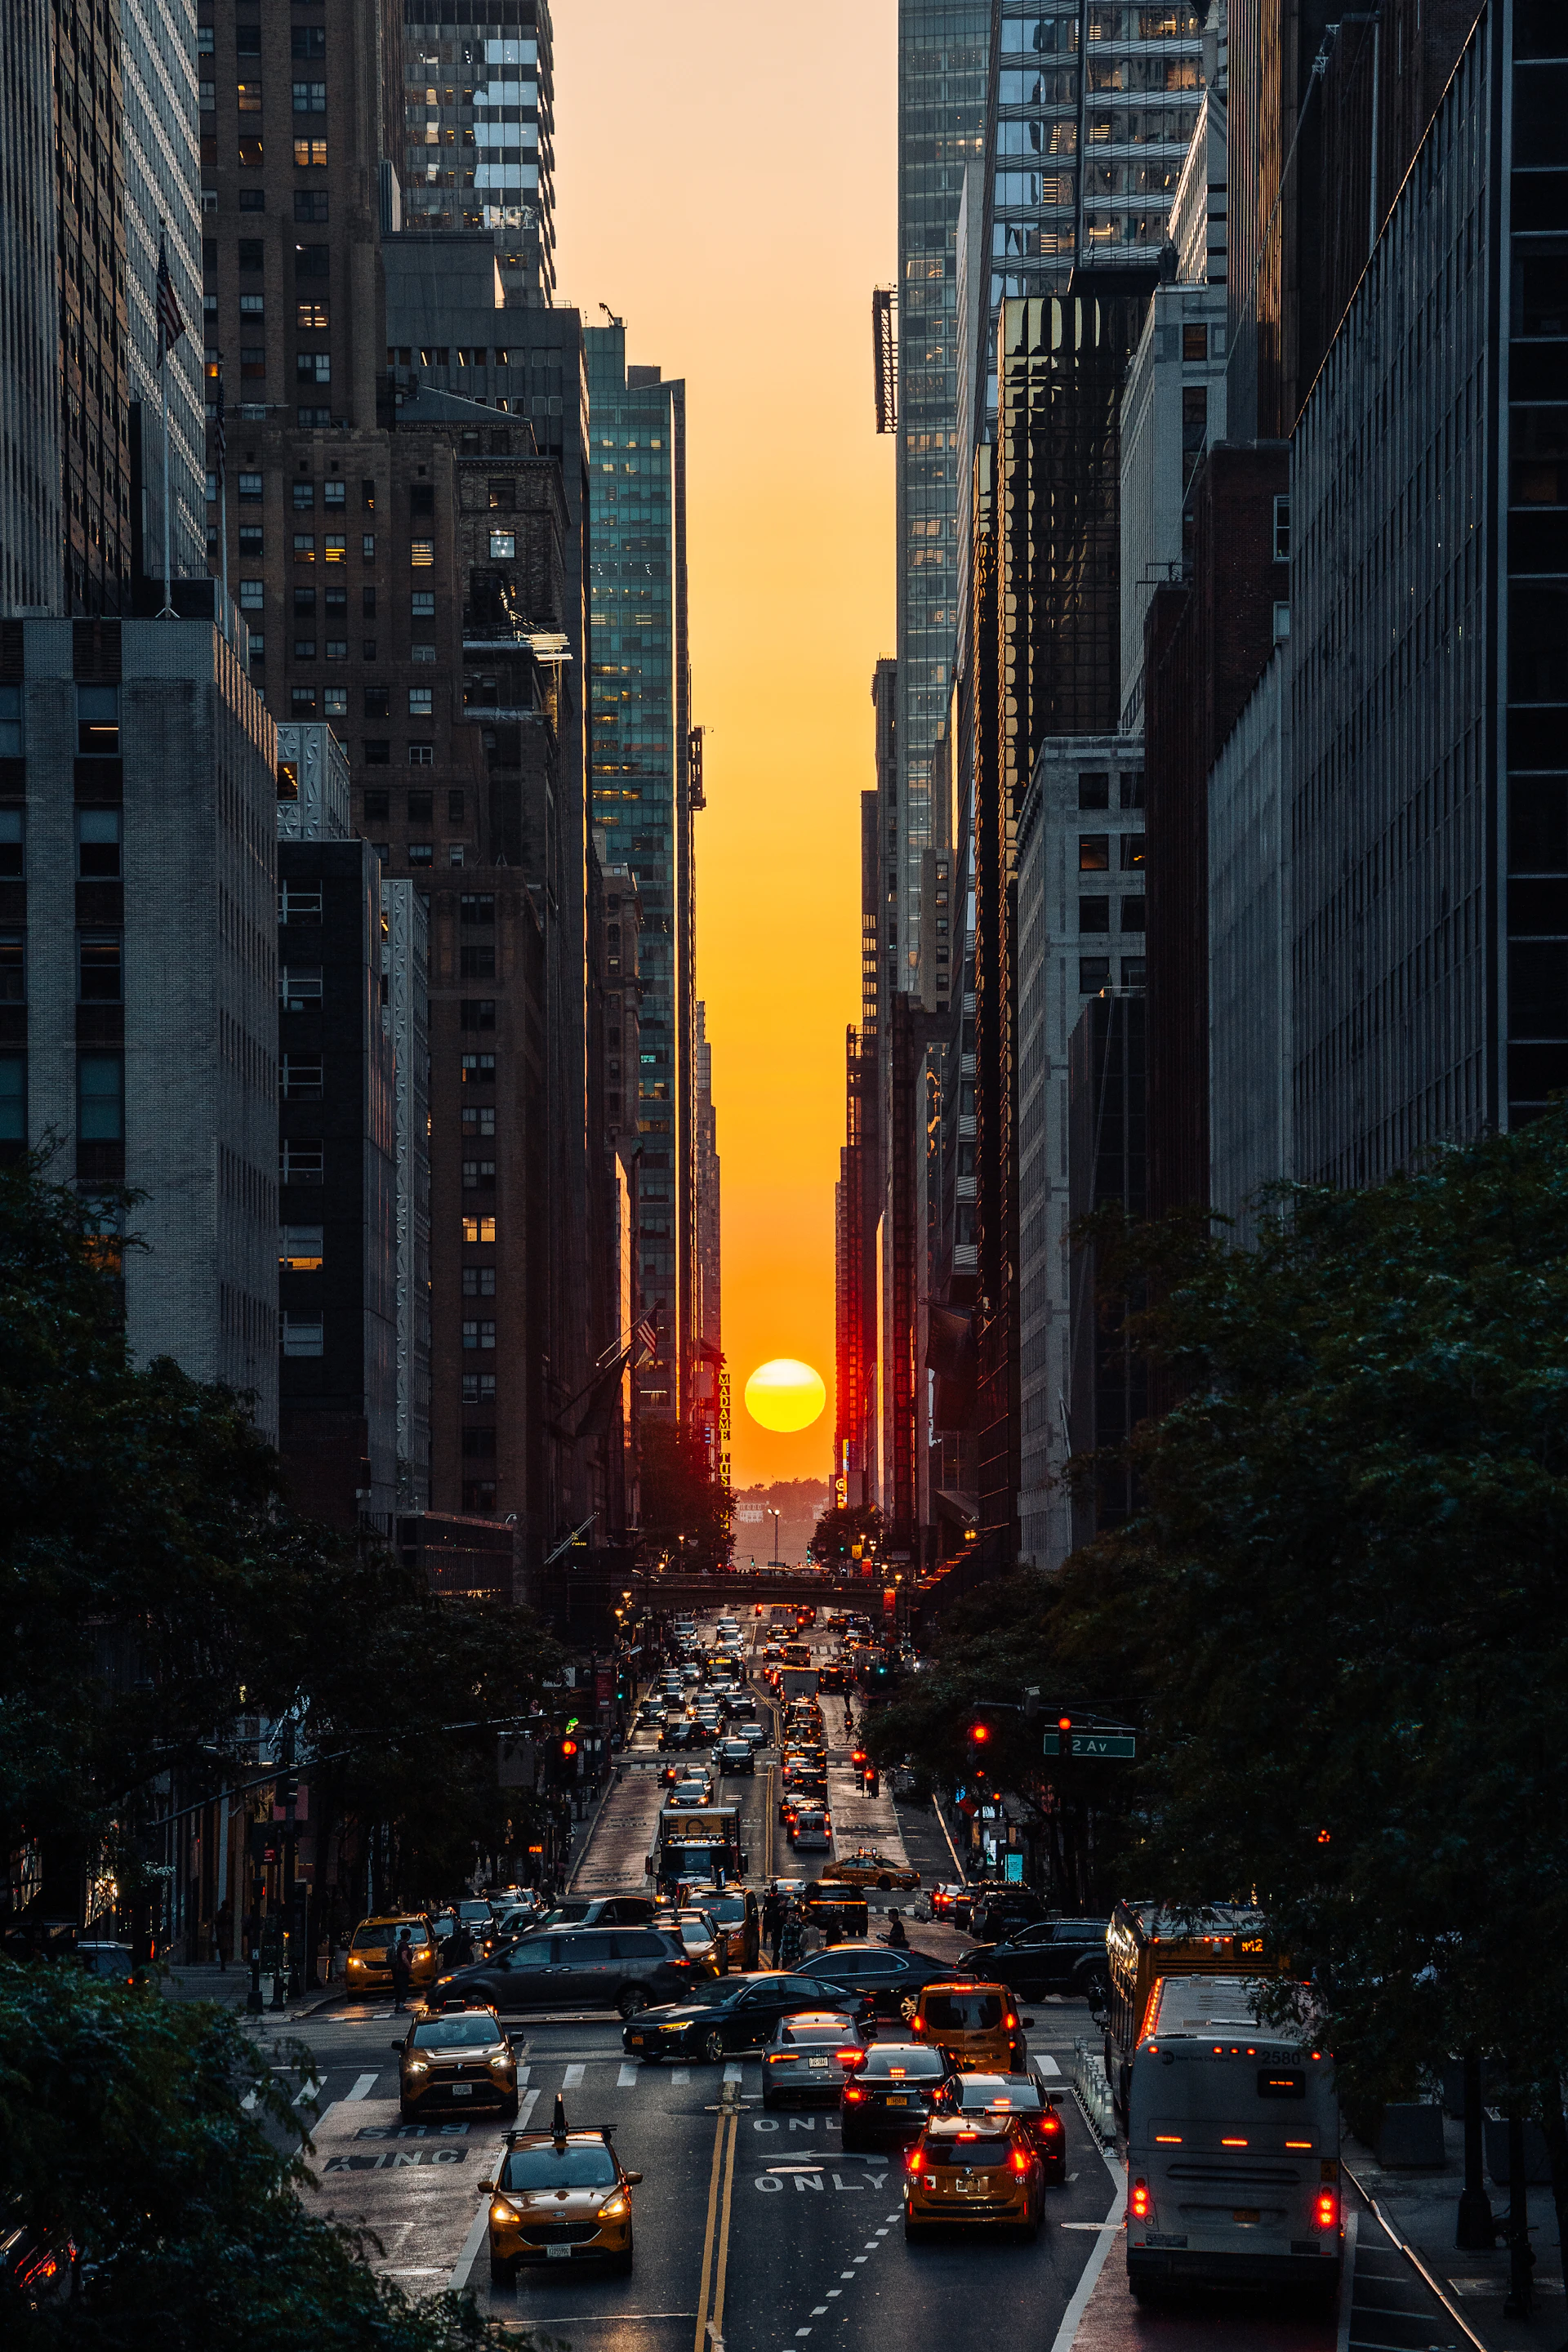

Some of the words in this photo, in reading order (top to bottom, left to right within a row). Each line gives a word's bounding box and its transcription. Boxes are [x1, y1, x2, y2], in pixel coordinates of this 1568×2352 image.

[718, 1374, 729, 1441] MADAME
[1072, 1740, 1081, 1751] 2
[1086, 1740, 1107, 1752] Av
[1262, 2051, 1301, 2065] 2580
[358, 2122, 470, 2140] BUS
[753, 2117, 843, 2132] ONL
[754, 2172, 889, 2193] ONLY
